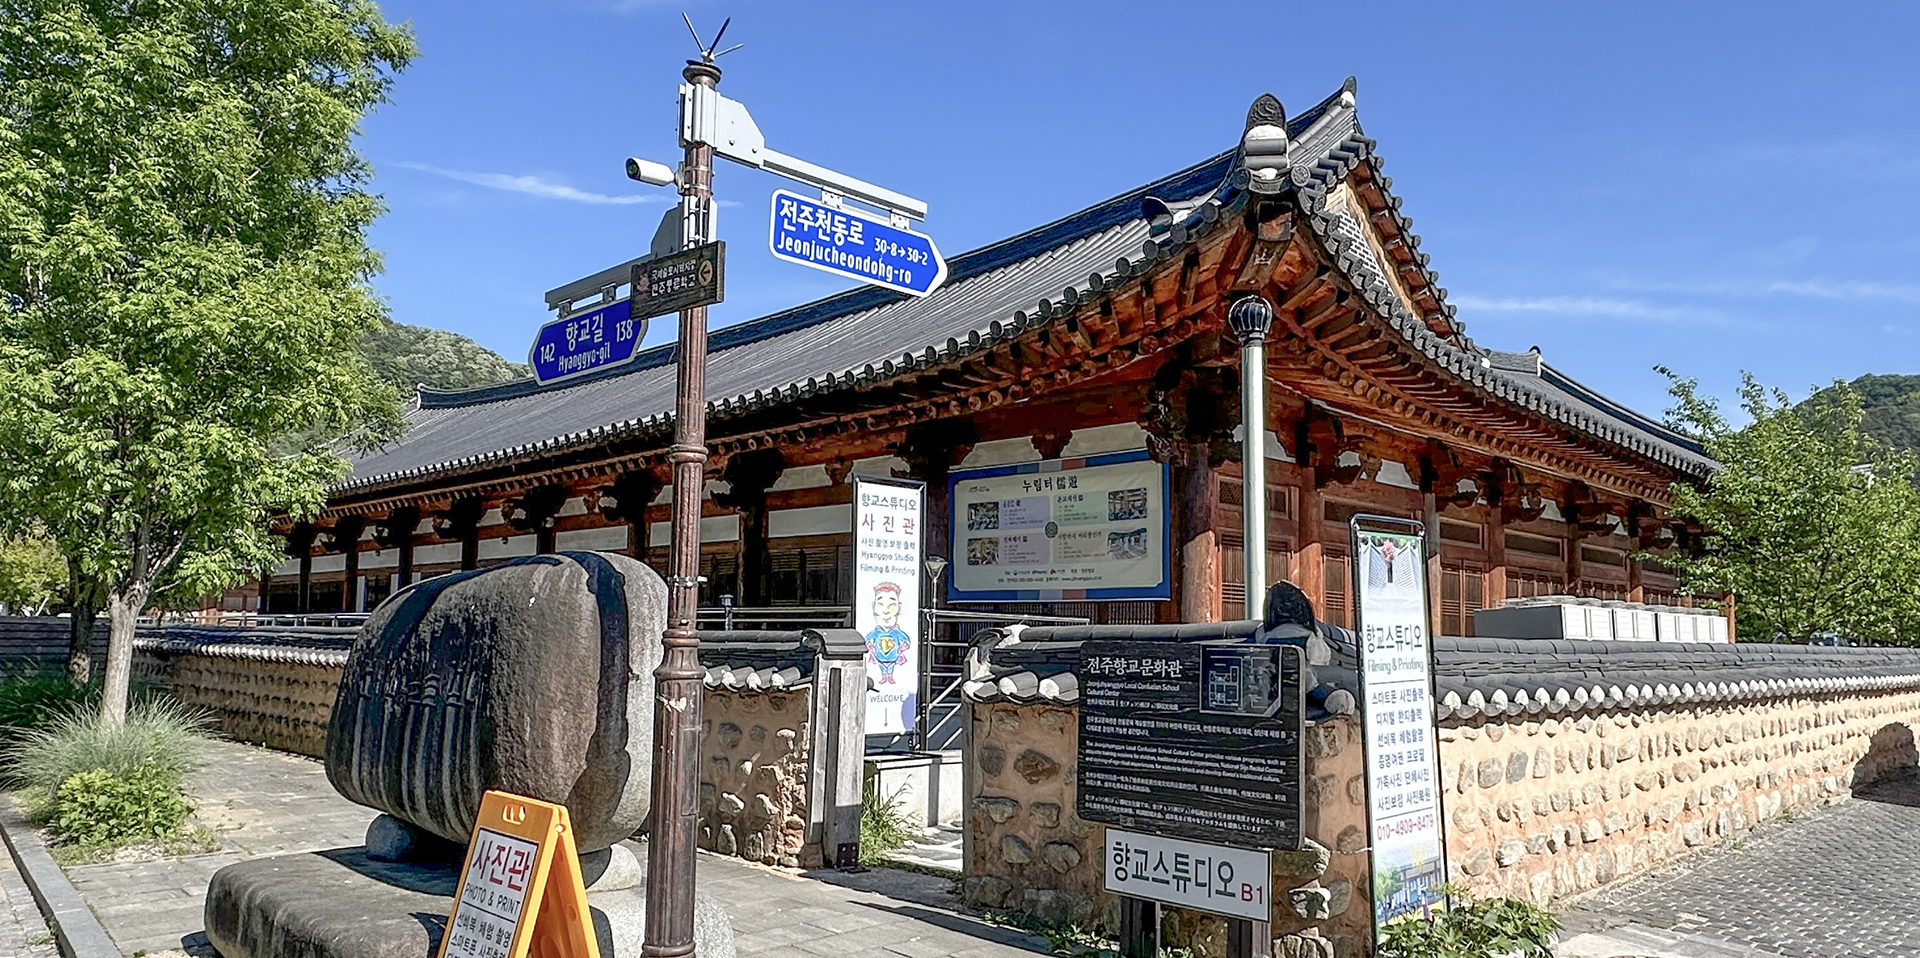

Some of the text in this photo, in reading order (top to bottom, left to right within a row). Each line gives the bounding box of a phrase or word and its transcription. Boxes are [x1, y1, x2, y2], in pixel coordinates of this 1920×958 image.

[779, 198, 865, 246] 전주천동로
[874, 237, 928, 266] 30-8 30-2
[540, 313, 633, 364] 142 향교길 138
[558, 342, 611, 373] Hyanggyo-gil
[1022, 476, 1053, 493] 누림터
[861, 493, 917, 511] 향교스튜디오
[861, 537, 874, 547] 사진
[861, 550, 915, 562] Hyanggyo Studio
[860, 563, 916, 576] Filming & Printing
[1366, 624, 1422, 653] 향교스튜디오
[1086, 656, 1184, 679] 전주향교문화관
[1367, 657, 1424, 675] Filming & Printing
[1104, 689, 1121, 697] Center
[1124, 682, 1137, 690] Local
[1137, 682, 1161, 691] Confucian
[1162, 684, 1180, 692] School
[1372, 687, 1424, 705] 스마트폰 사진출력
[869, 694, 904, 703] WELCOME
[1376, 711, 1395, 726] 디지털
[1377, 732, 1397, 748] 선비복
[1407, 748, 1425, 763] 프로필
[1376, 768, 1430, 790] 가족사진 단체사진
[1377, 788, 1431, 811] 사진보정 사진복원
[472, 840, 531, 892] 사진관
[1112, 841, 1263, 905] 향교스튜디오 B1
[464, 882, 521, 916] PHOTO & PRINT
[450, 932, 477, 956] 스마트폰
[478, 921, 495, 941] 체험
[495, 927, 512, 948] 촬영
